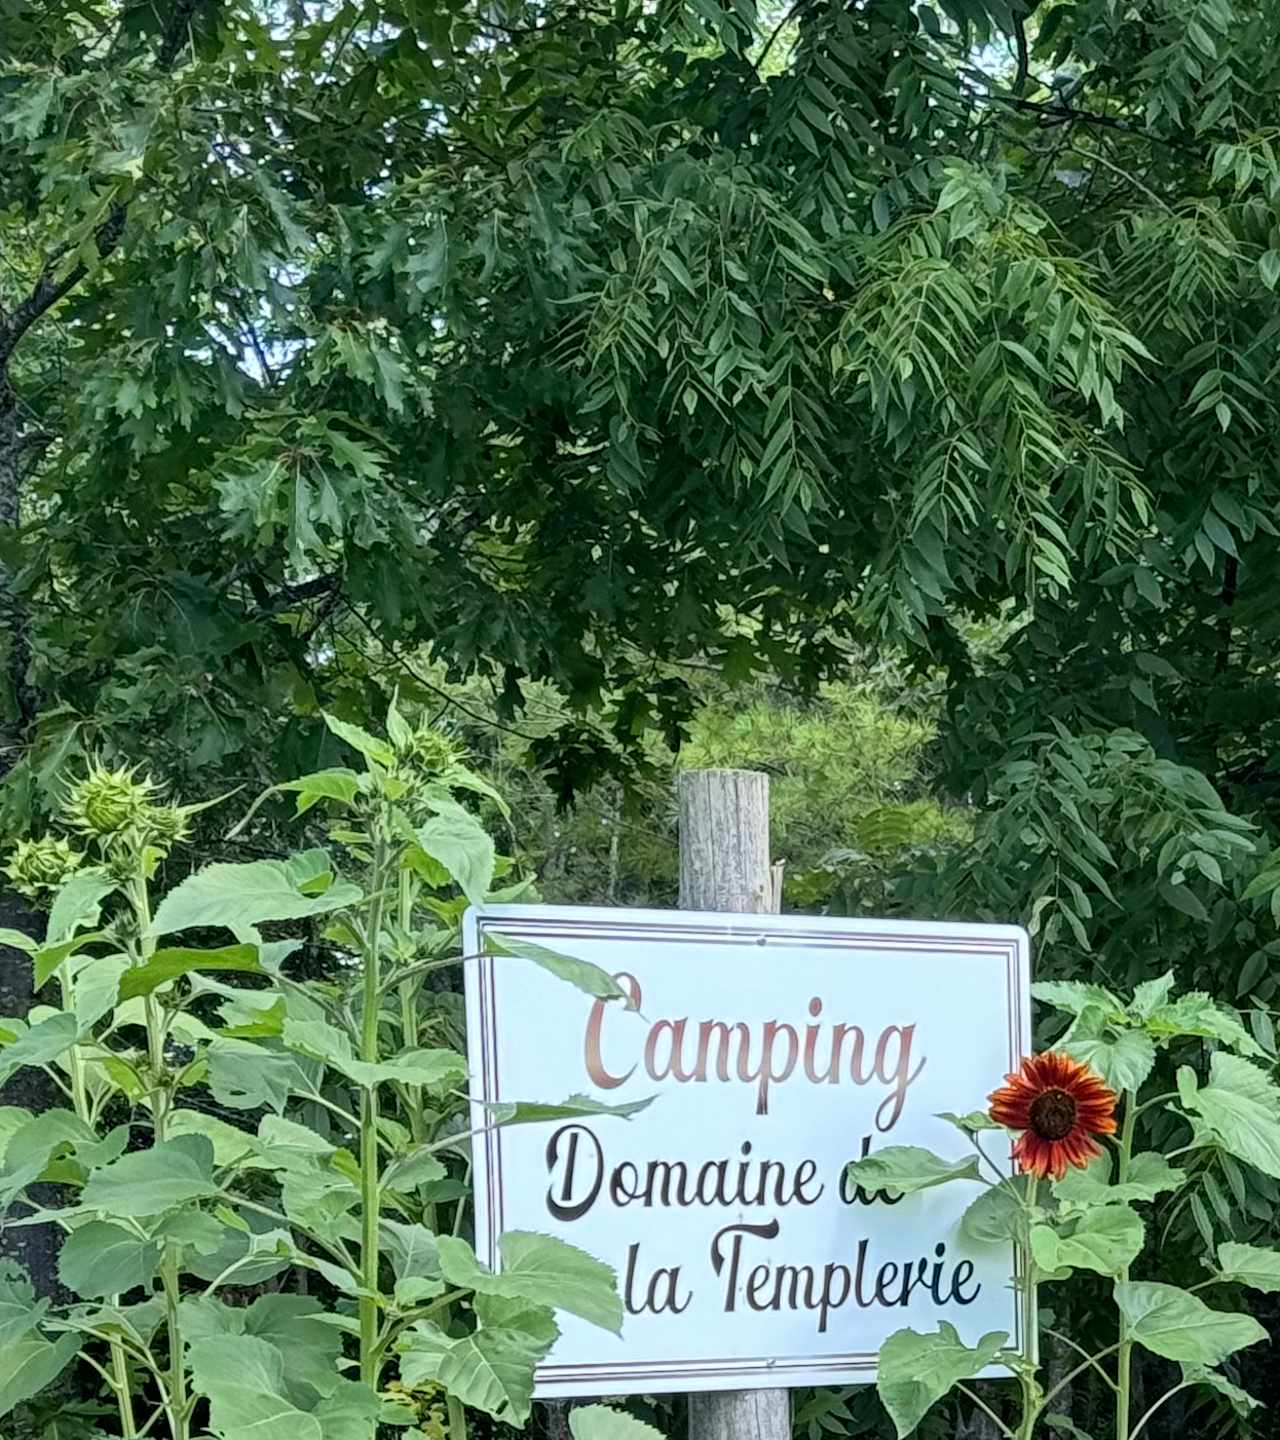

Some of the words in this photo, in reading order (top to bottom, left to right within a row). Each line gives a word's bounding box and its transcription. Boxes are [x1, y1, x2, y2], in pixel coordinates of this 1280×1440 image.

[583, 971, 927, 1133] Camping
[545, 1123, 825, 1223] Domaine
[624, 1241, 694, 1316] la
[710, 1218, 982, 1333] Templerie
